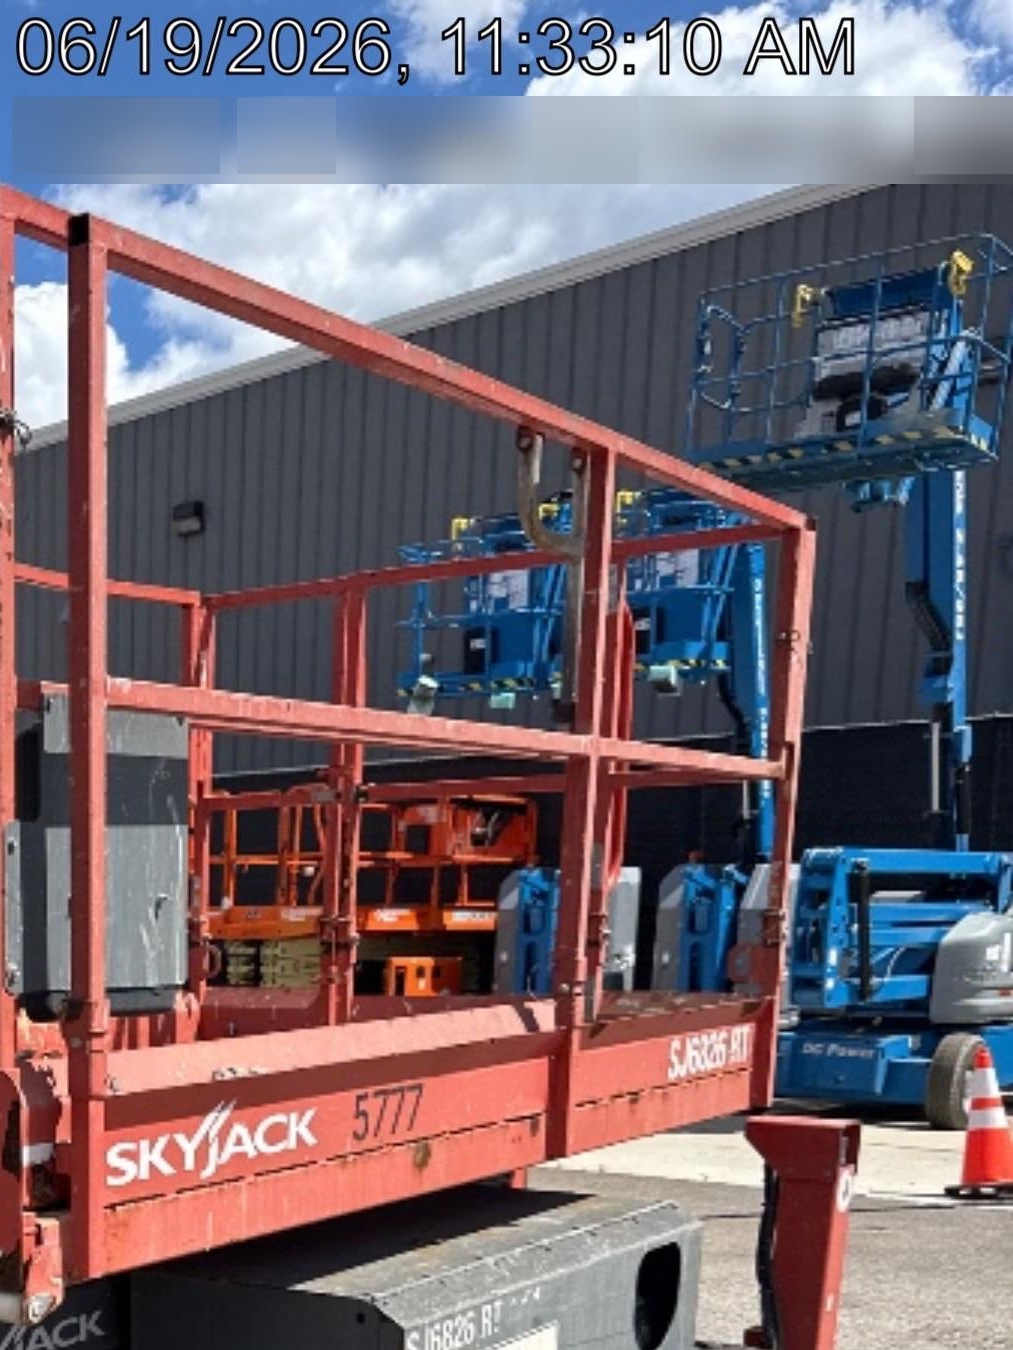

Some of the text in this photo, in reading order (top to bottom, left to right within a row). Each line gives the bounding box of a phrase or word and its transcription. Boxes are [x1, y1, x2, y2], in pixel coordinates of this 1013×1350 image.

[826, 1043, 876, 1058] Power
[353, 1083, 424, 1141] 5777
[106, 1099, 318, 1186] SKYJACK
